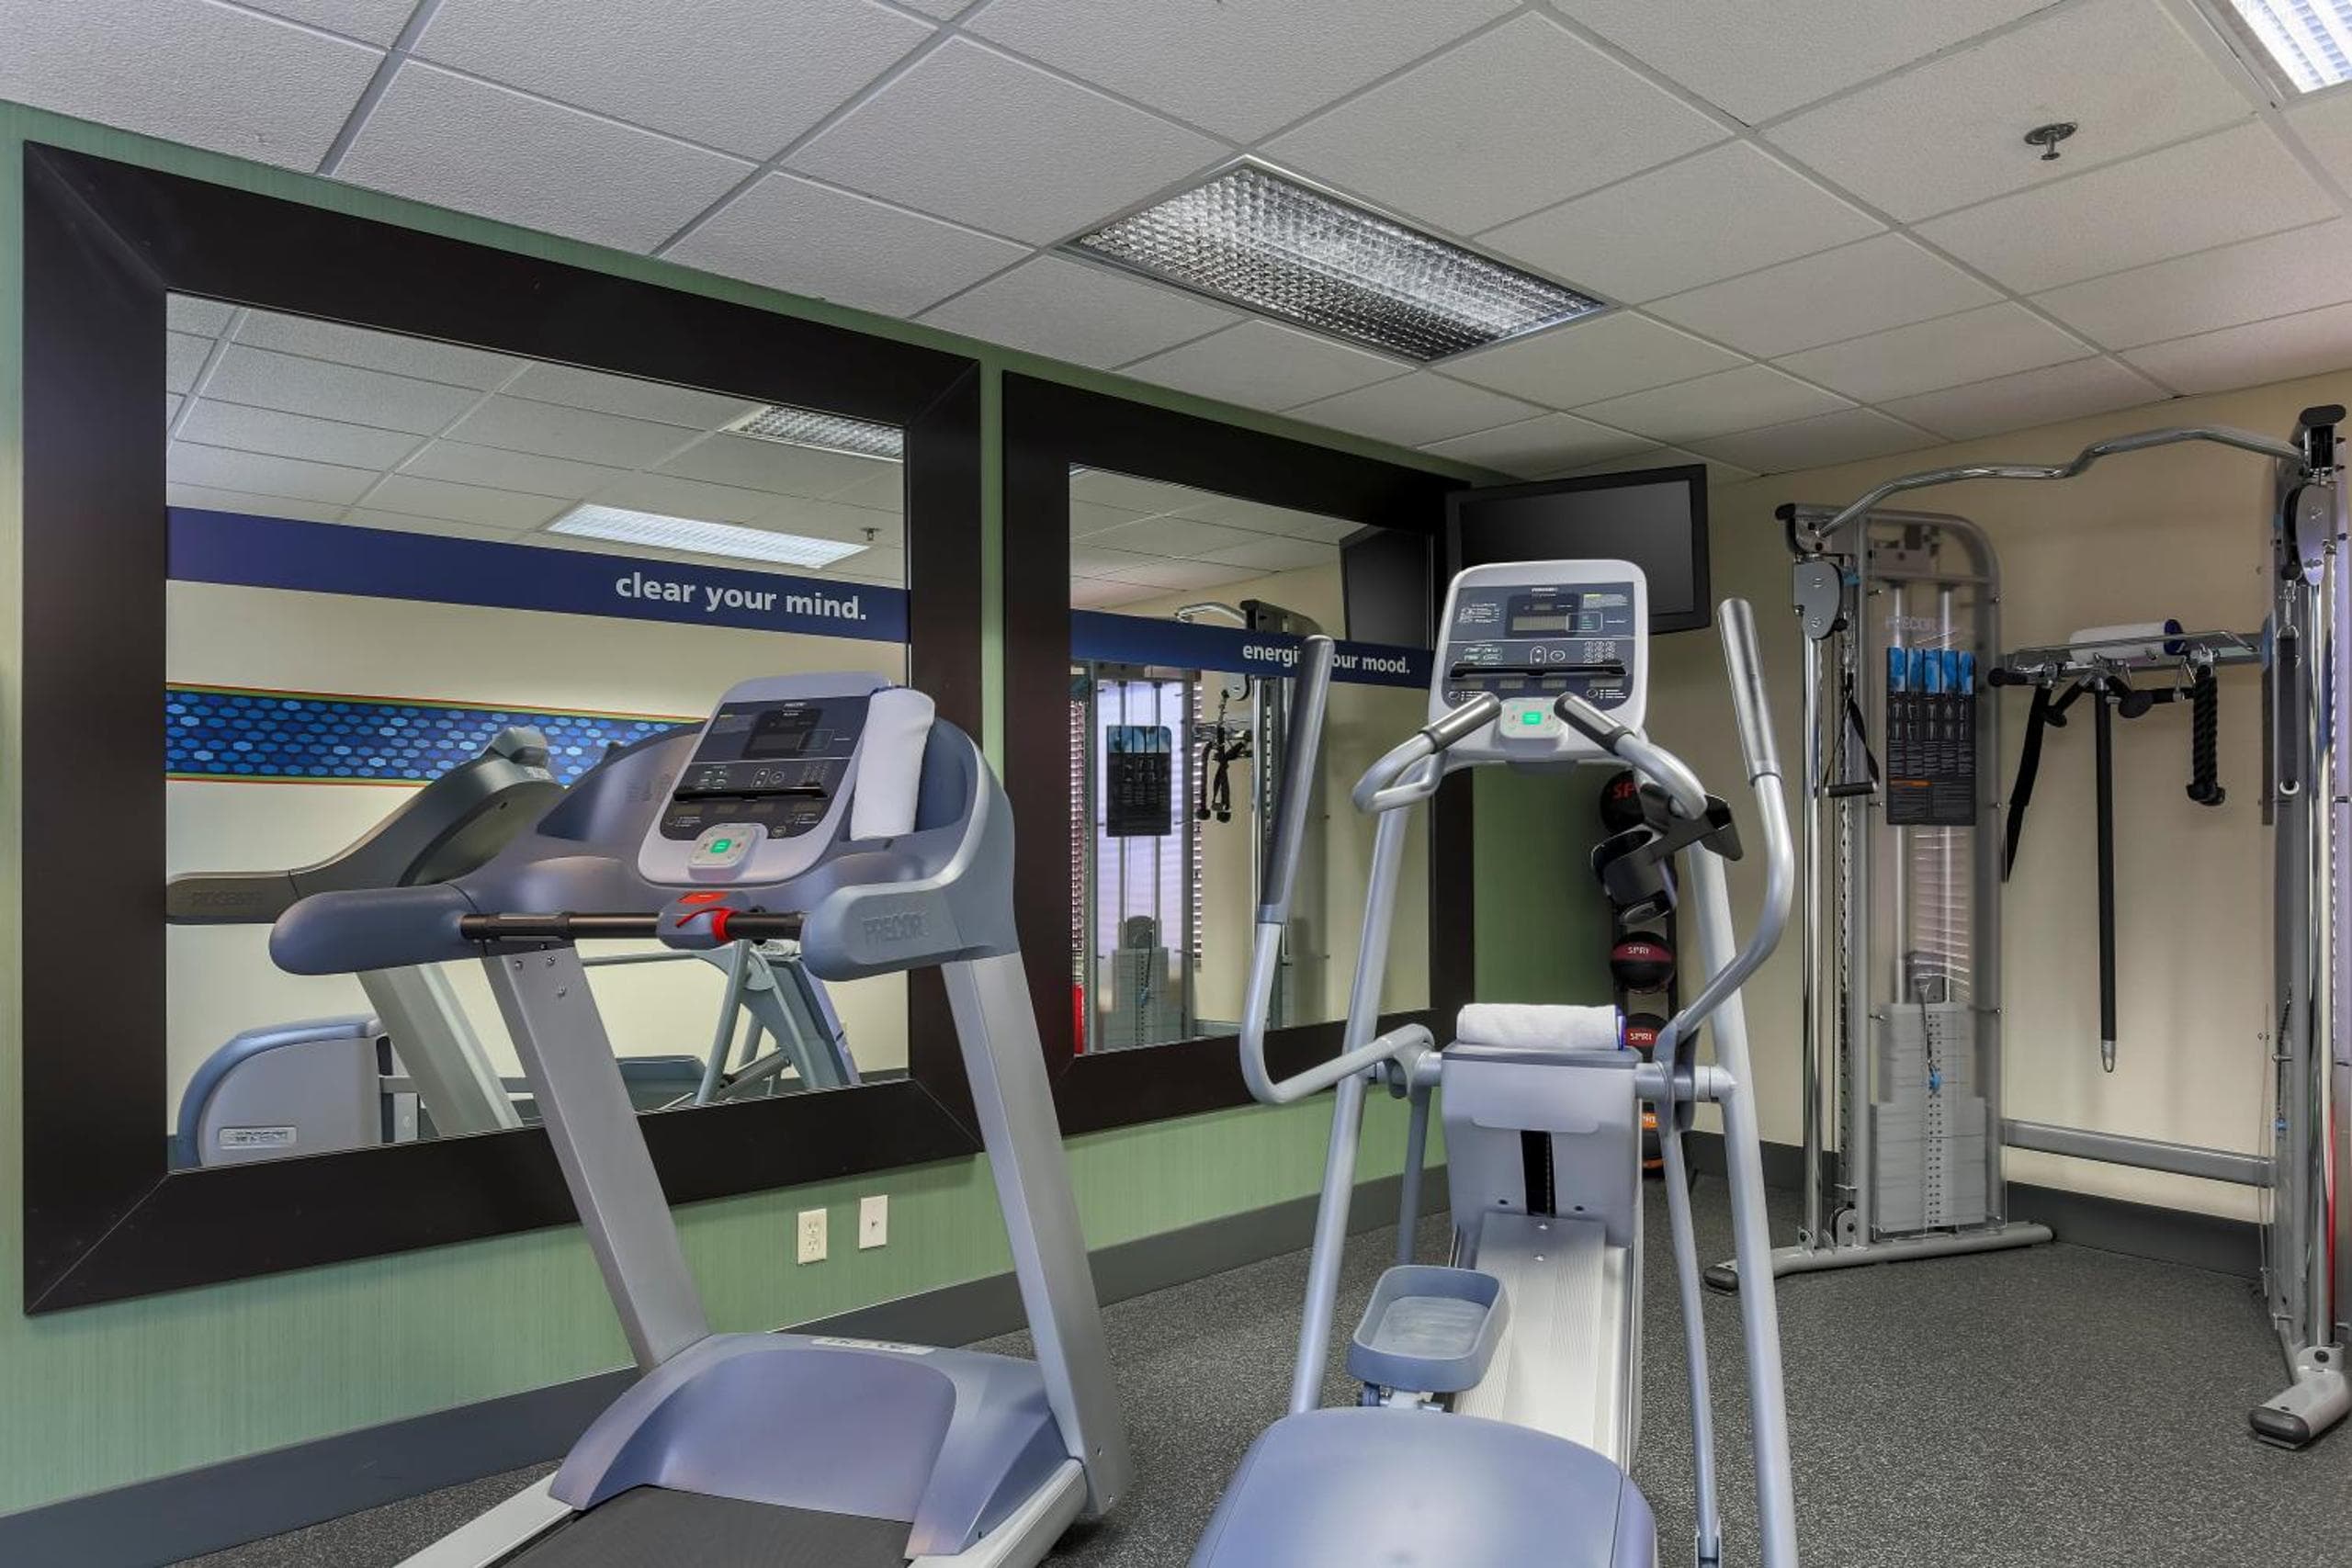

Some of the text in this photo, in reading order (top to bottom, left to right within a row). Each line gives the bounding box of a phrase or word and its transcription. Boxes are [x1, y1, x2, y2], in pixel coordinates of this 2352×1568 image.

[616, 571, 866, 620] clear your mind.
[1242, 645, 1410, 674] energi our mood.
[1627, 946, 1649, 954] SPRI
[1630, 1032, 1652, 1041] SPRI
